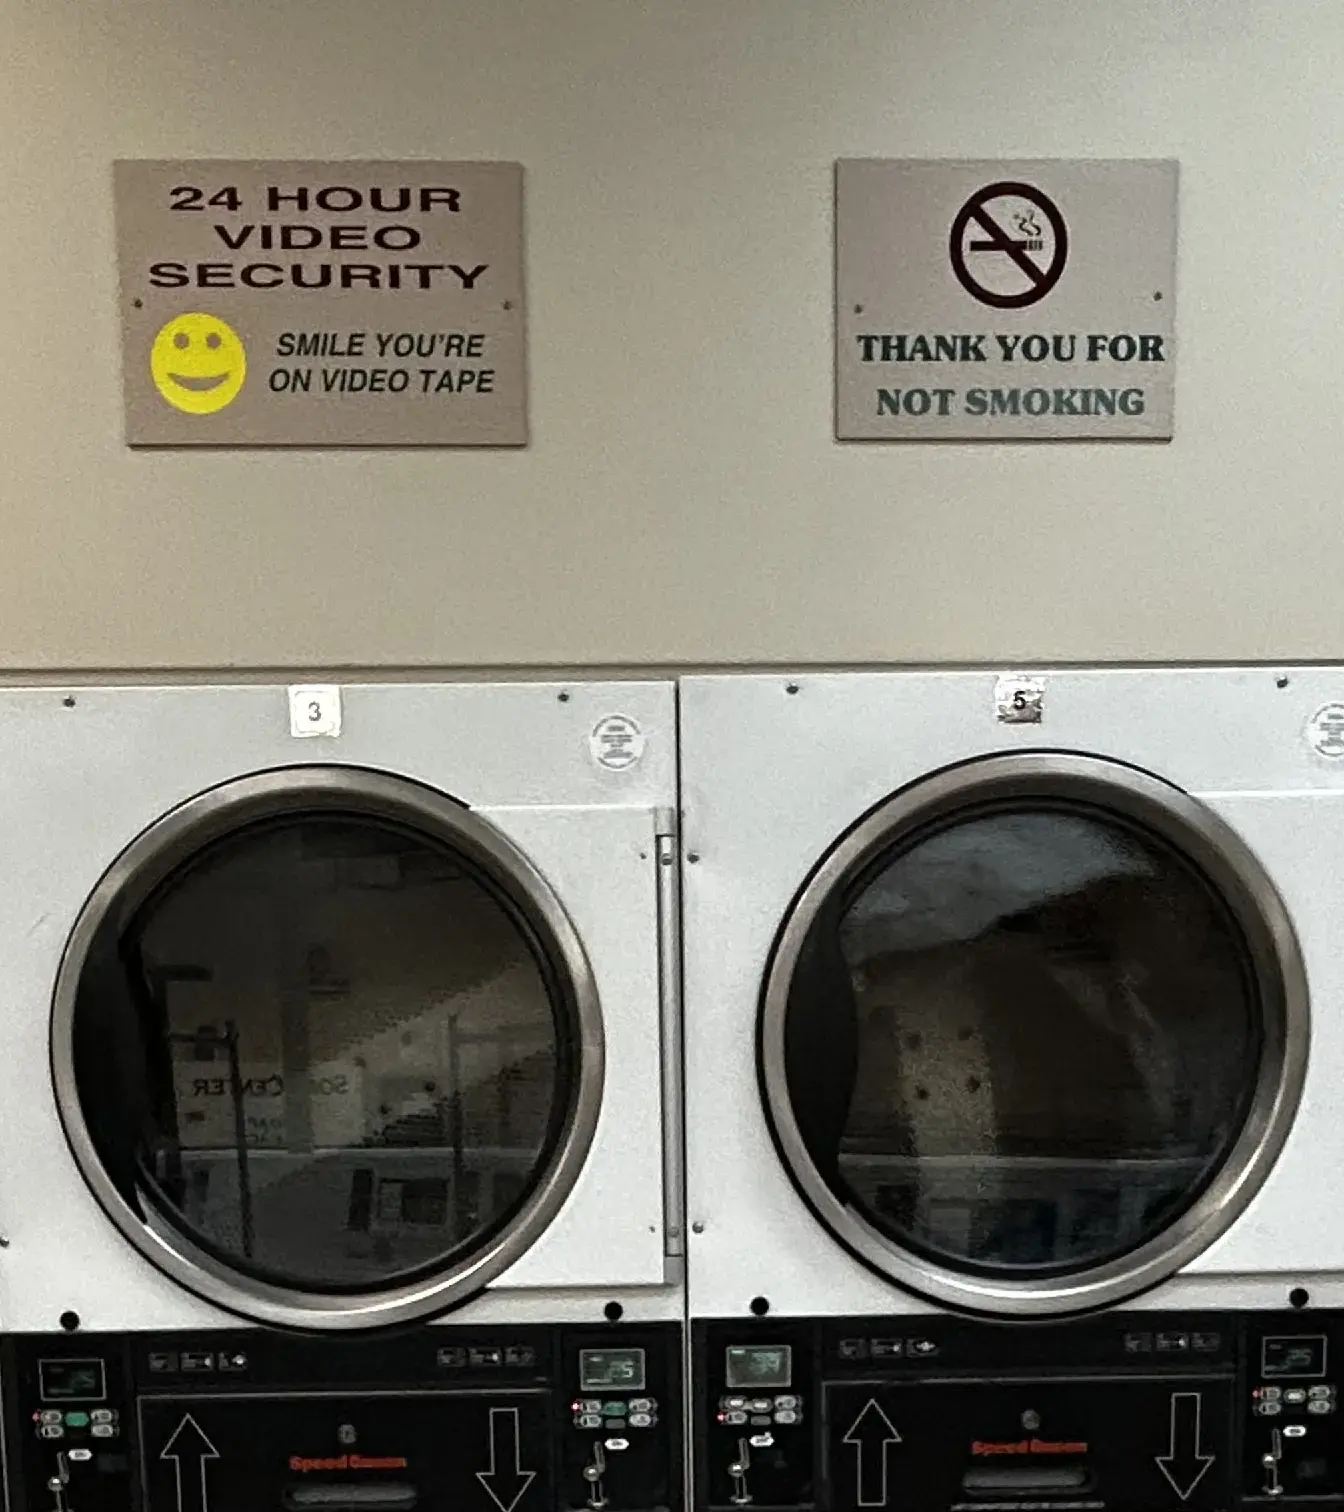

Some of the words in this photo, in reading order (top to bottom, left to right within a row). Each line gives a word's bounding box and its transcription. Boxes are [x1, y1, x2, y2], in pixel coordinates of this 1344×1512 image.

[170, 186, 242, 212] 24
[267, 187, 462, 213] HOUR
[214, 225, 421, 250] VIDEO
[149, 263, 490, 290] SECURITY
[276, 333, 366, 357] SMILE
[376, 333, 485, 358] YOU'RE
[856, 334, 987, 362] THANK
[995, 334, 1076, 362] YOU
[1086, 334, 1165, 362] FOR
[269, 369, 316, 393] ON
[323, 369, 409, 393] VIDEO
[419, 370, 495, 393] TAPE
[876, 388, 955, 416] NOT
[964, 388, 1145, 416] SMOKING
[307, 700, 321, 721] 3
[1013, 690, 1026, 710] 5
[289, 1455, 348, 1473] Speed
